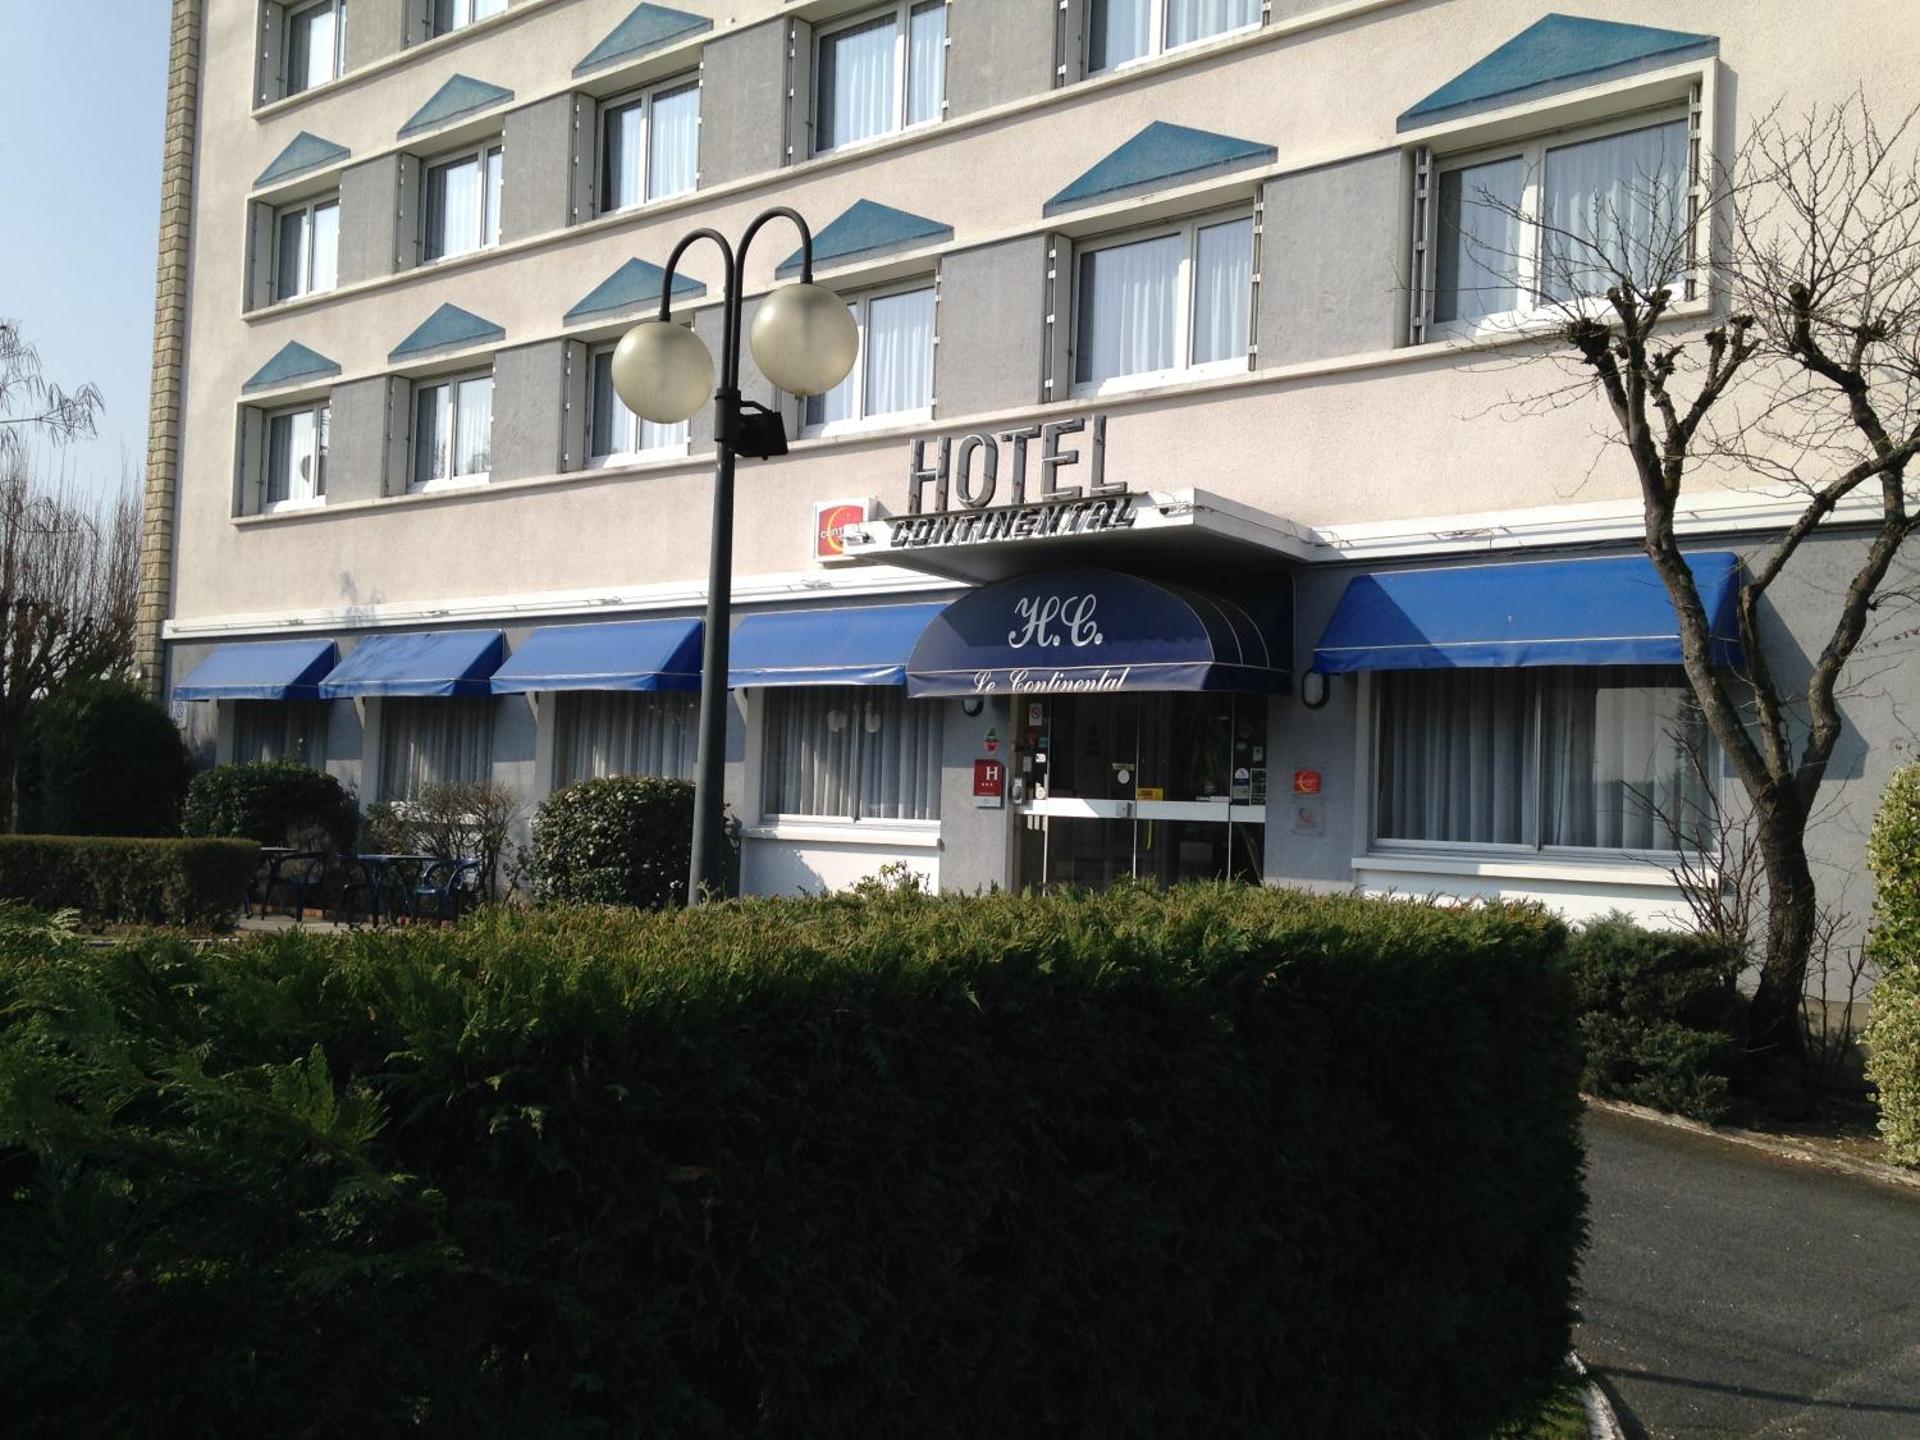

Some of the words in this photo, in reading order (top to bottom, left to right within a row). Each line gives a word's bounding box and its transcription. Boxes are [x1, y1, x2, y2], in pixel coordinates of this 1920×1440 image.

[908, 415, 1127, 514] HOTEL
[890, 497, 1137, 548] CONTINENTAL
[973, 671, 996, 694] Le
[1009, 667, 1131, 694] Continental
[986, 766, 998, 780] H
